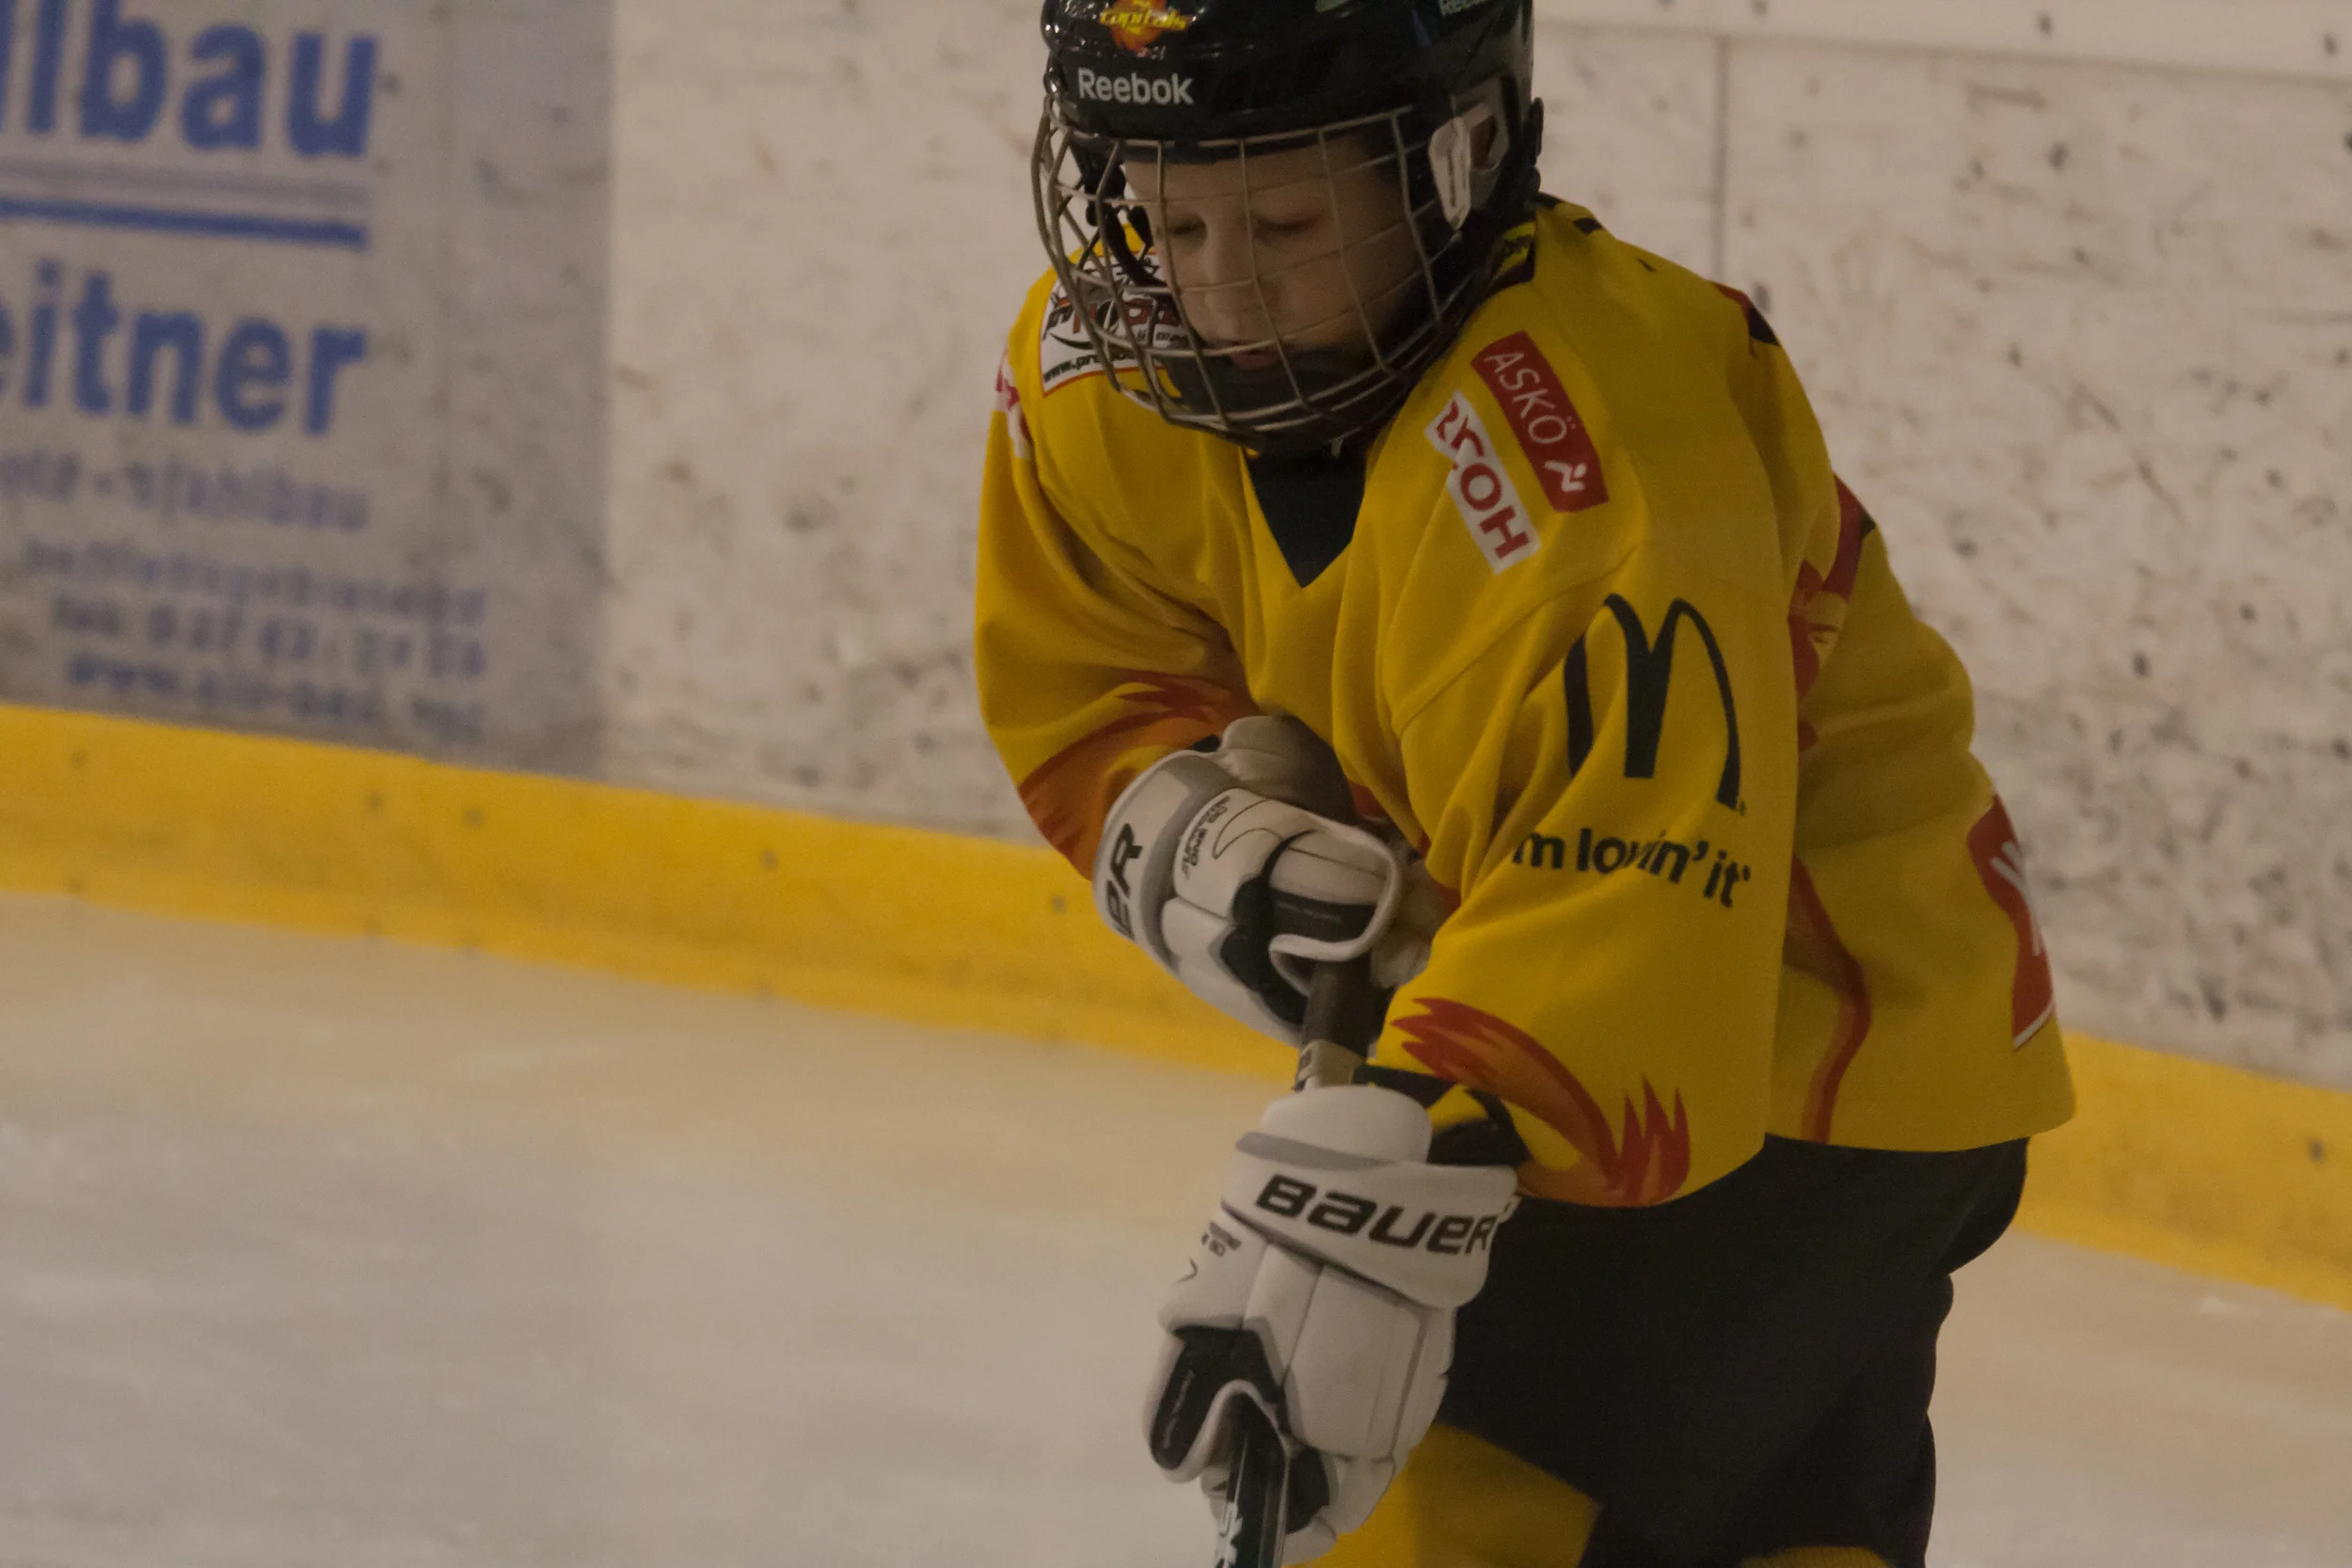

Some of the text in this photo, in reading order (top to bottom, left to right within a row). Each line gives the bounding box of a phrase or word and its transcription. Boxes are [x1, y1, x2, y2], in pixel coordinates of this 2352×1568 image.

[0, 0, 378, 158] lbau
[1077, 67, 1194, 104] Reebok
[0, 261, 369, 438] itner
[1484, 351, 1577, 445] ASKÖ
